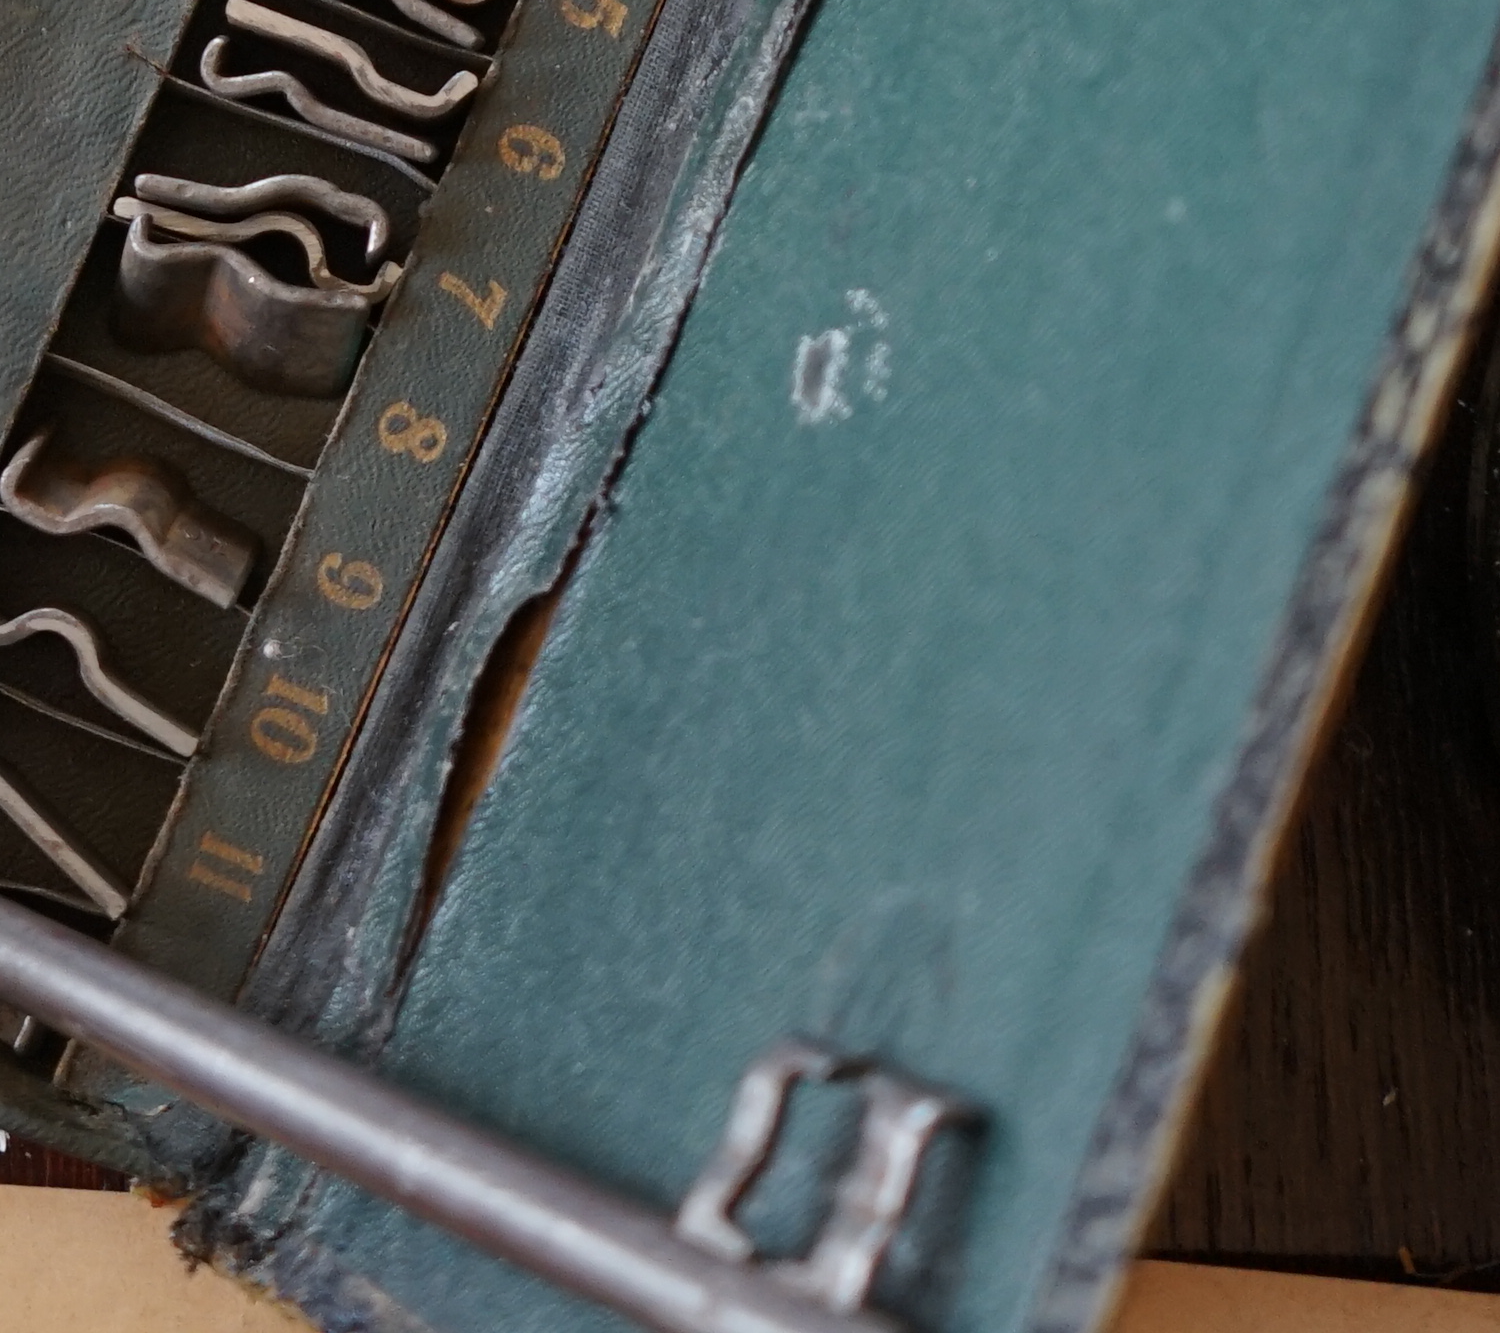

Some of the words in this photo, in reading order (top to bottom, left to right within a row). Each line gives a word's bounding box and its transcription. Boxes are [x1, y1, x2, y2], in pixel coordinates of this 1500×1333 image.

[498, 124, 565, 181] 6
[440, 271, 508, 330] 7
[378, 402, 447, 463] 8
[316, 553, 384, 610] 9
[252, 674, 330, 765] 10
[190, 831, 264, 903] 11
